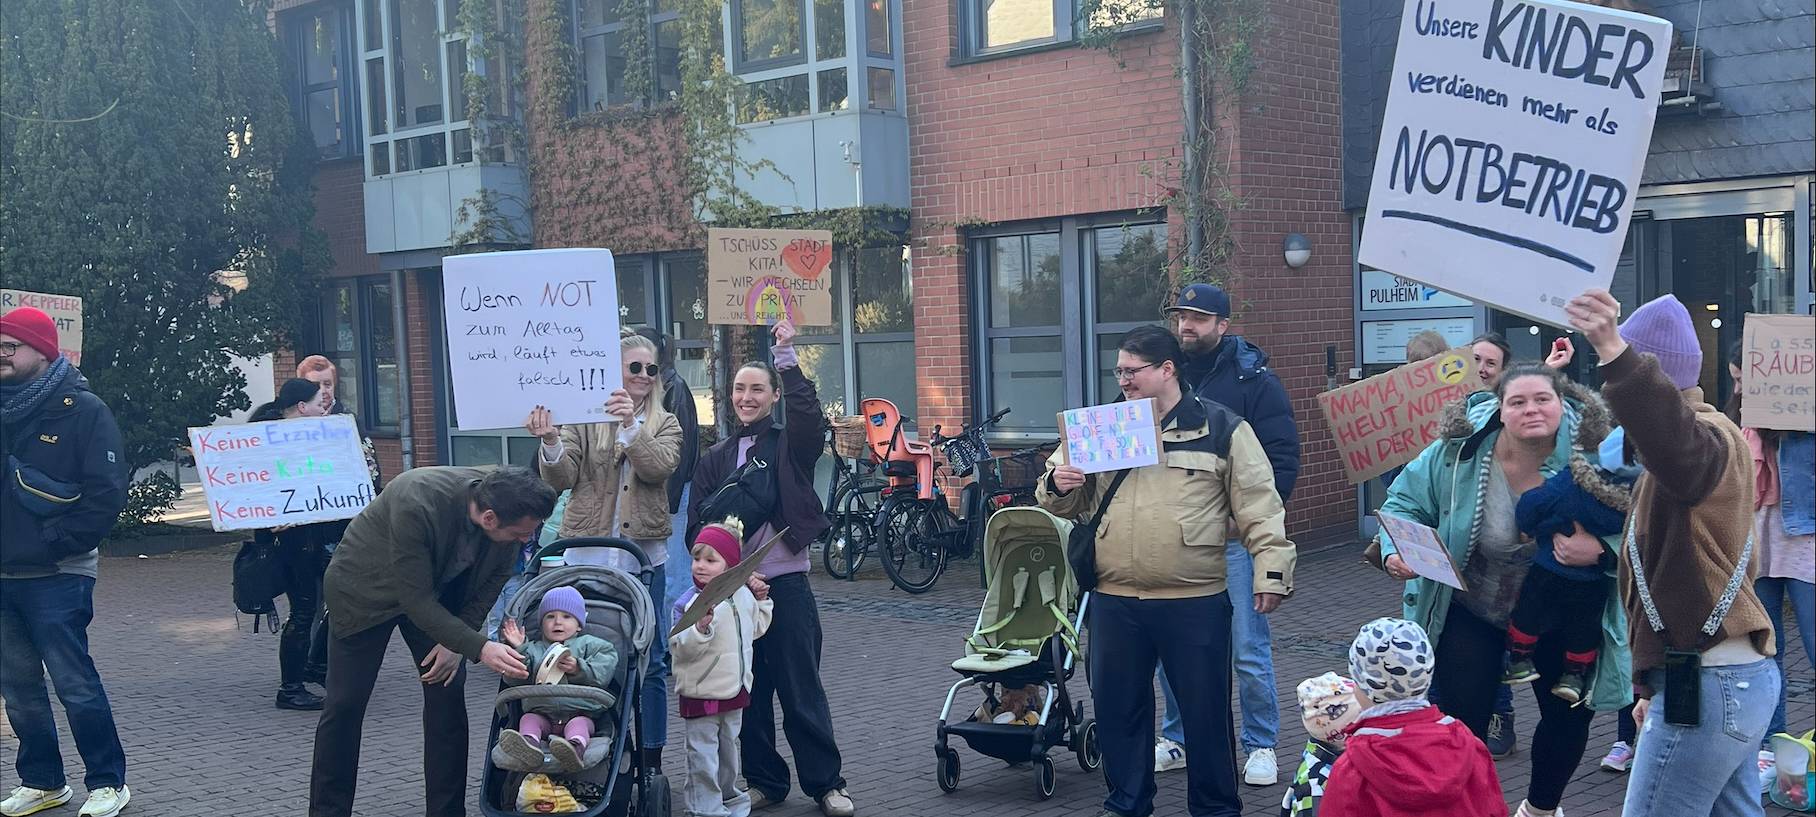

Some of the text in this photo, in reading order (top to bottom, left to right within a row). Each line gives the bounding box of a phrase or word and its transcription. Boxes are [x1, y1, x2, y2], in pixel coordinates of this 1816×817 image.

[1415, 0, 1654, 99] Unsere KINDER
[1408, 71, 1618, 135] verdienen mehr als
[1389, 125, 1628, 234] NOTBETRIEB
[720, 236, 778, 253] TSCHÜSS
[749, 255, 783, 271] KITA!
[763, 277, 824, 290] WECHSELN
[1394, 275, 1418, 287] STAD
[18, 294, 80, 311] KEPPELER
[460, 280, 597, 312] Wenn NOT
[726, 293, 806, 308] ZU PRIVAT
[1370, 287, 1418, 303] PULHEIM
[523, 320, 584, 342] Alltag
[514, 345, 557, 365] läuft
[570, 348, 606, 358] etwas
[1406, 361, 1438, 389] IST
[1770, 401, 1815, 415] sei
[1336, 405, 1400, 447] HEUT
[198, 431, 261, 454] Keine
[1349, 447, 1373, 472] IN
[1376, 428, 1417, 462] DER
[206, 465, 271, 487] Keine
[215, 498, 277, 522] Keine
